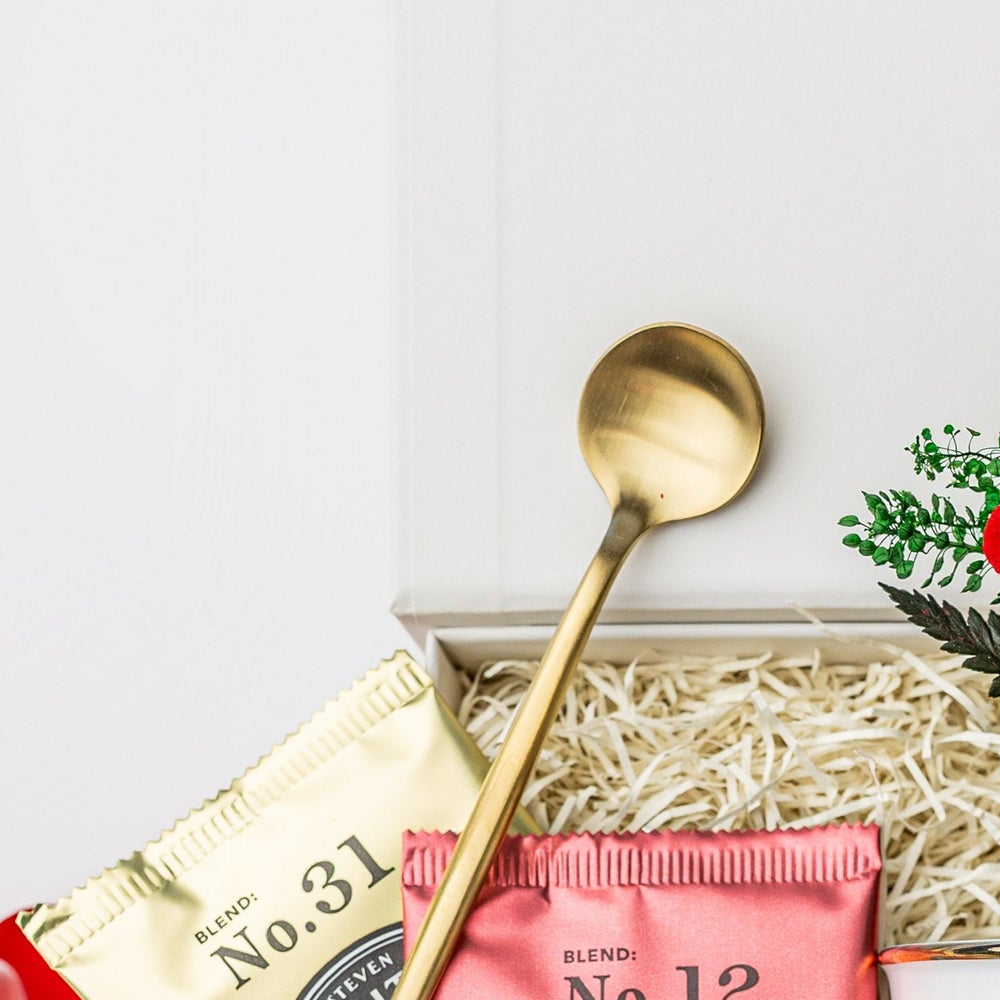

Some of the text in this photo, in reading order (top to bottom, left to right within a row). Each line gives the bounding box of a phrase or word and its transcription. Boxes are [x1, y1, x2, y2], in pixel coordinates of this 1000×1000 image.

[194, 893, 258, 944] BLEND:
[210, 835, 395, 990] No.31
[563, 947, 637, 963] BLEND:
